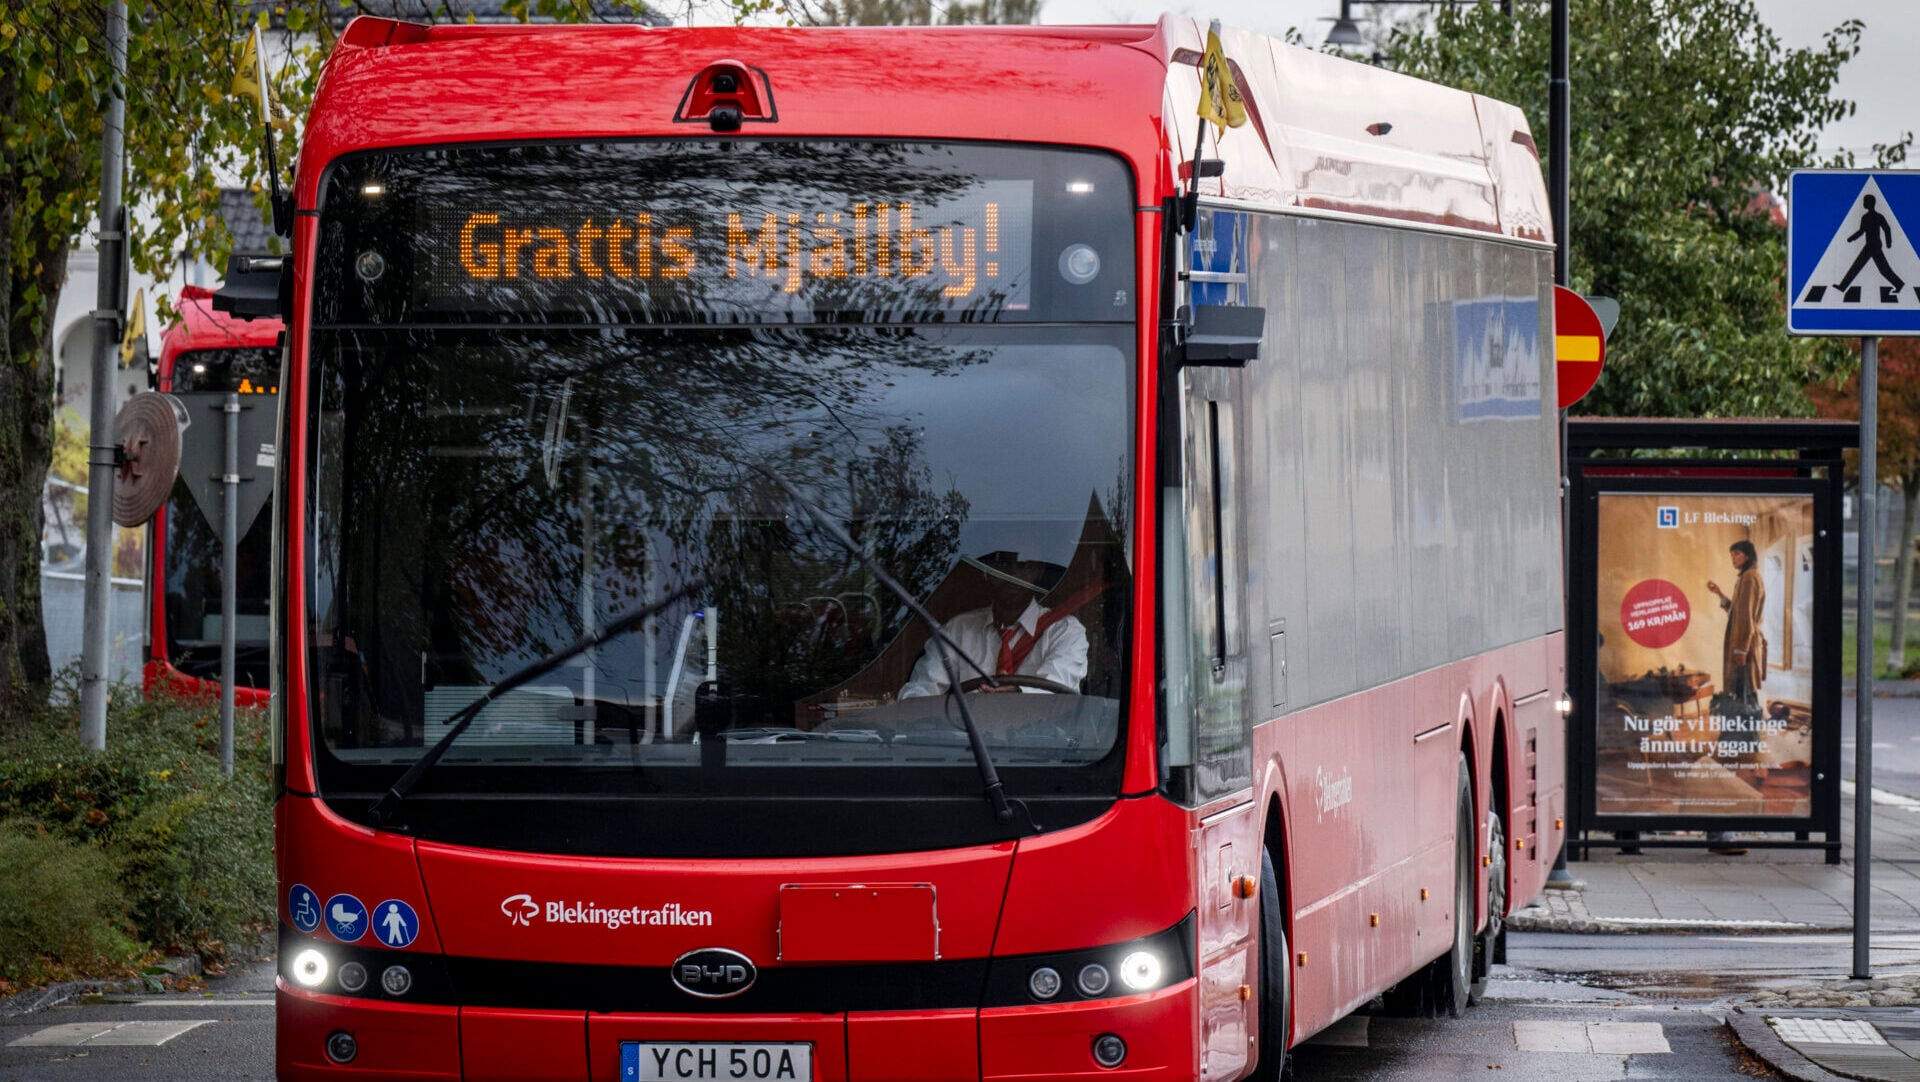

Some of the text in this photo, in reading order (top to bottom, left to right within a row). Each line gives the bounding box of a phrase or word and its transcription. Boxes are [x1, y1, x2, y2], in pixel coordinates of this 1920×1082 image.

[459, 202, 1000, 297] Grattis Mjällby!
[1684, 512, 1757, 526] LF Blekinge
[1647, 610, 1687, 627] KR/MÅN
[1623, 715, 1788, 736] Nu gör vi Blekinge
[1640, 736, 1771, 757] ännu tryggare.
[545, 900, 713, 930] Blekingetrafiken
[681, 964, 747, 984] BYD
[652, 1048, 796, 1079] YCH 50A
